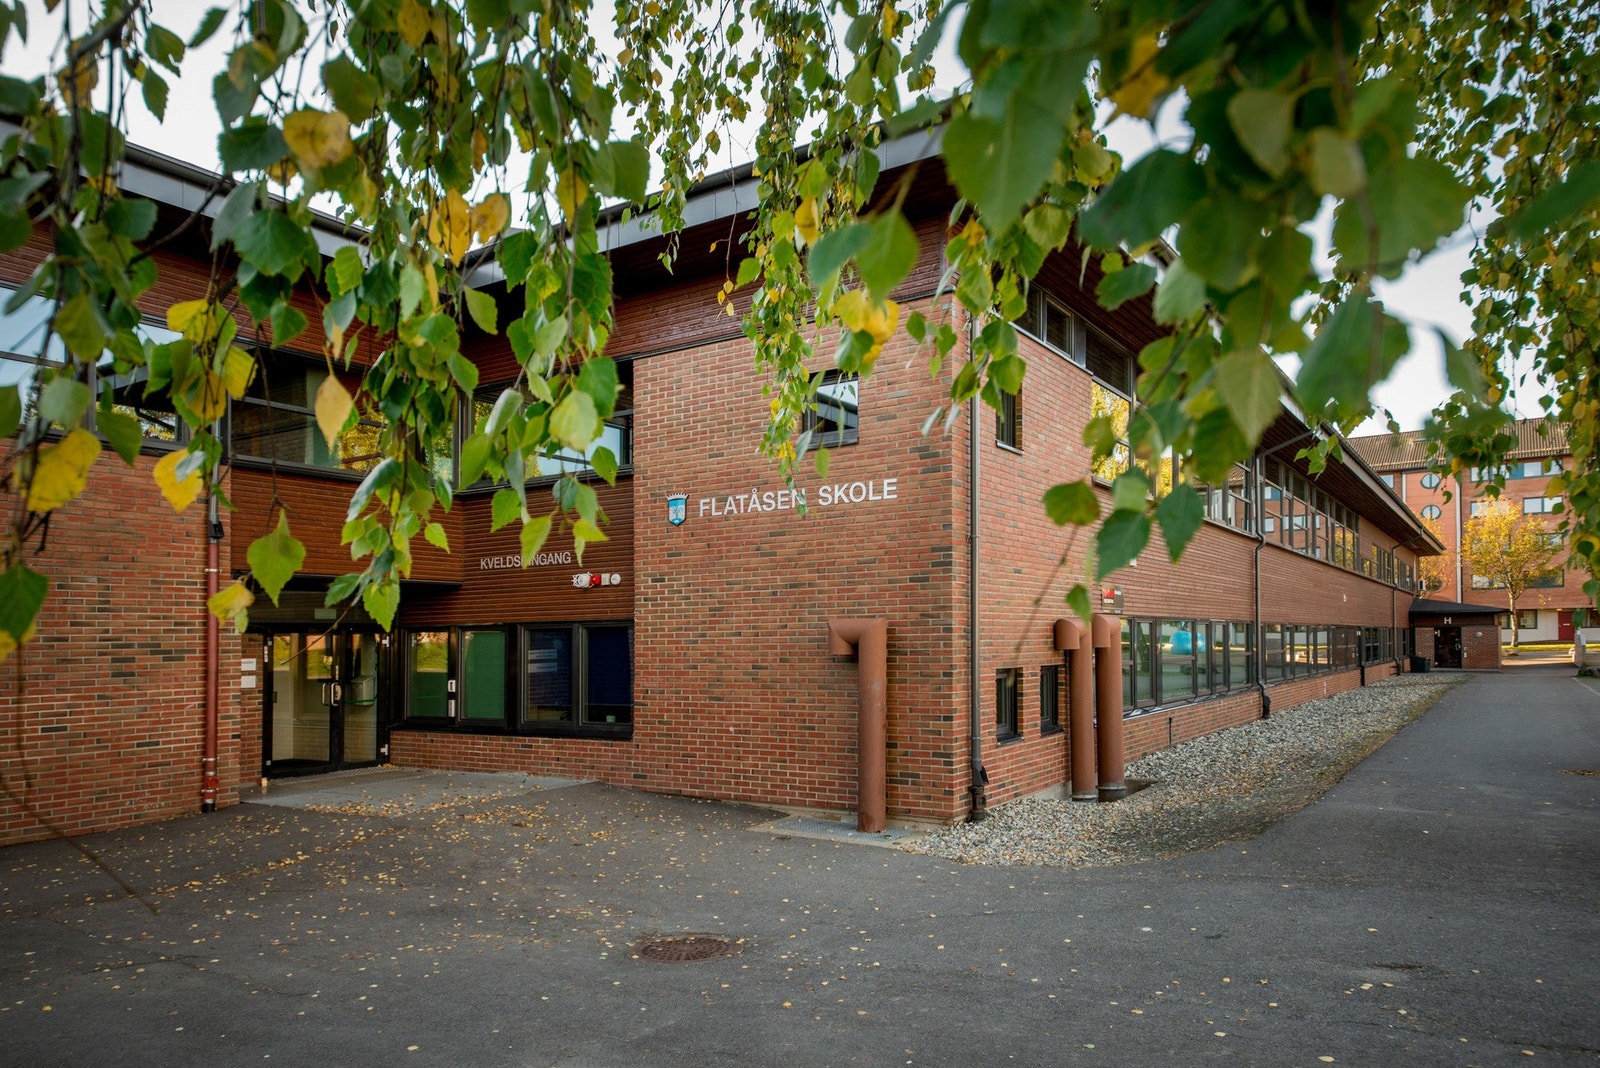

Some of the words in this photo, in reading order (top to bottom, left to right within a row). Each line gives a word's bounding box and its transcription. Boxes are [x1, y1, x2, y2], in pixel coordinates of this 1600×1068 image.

[699, 488, 806, 517] FLATÅSEN
[818, 478, 898, 506] SKOLE
[1443, 616, 1452, 625] H
